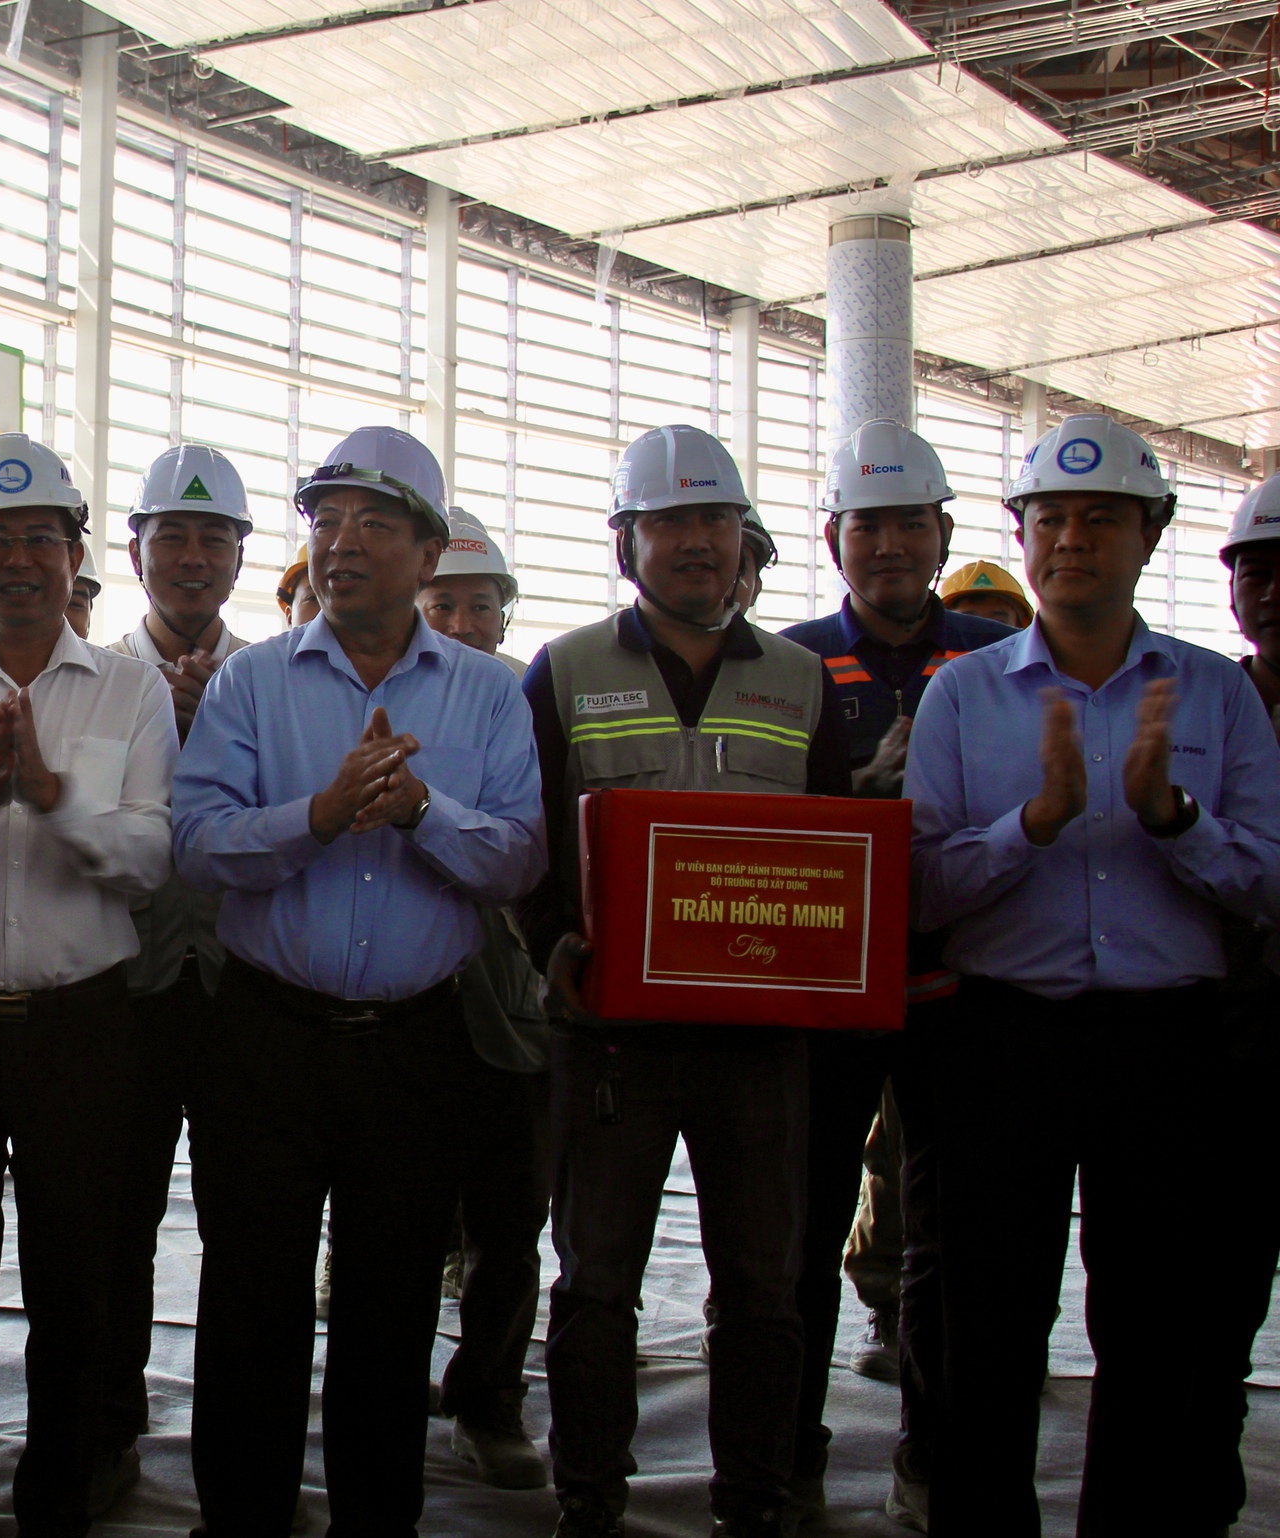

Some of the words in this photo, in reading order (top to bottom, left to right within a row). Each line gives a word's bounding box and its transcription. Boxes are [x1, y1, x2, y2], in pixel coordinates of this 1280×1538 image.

[587, 694, 620, 705] FUJITA
[623, 692, 643, 702] E&C
[687, 860, 705, 872] VIÊN
[706, 863, 723, 873] BAN
[747, 863, 770, 875] HÀNH
[771, 866, 798, 877] TRUNG
[710, 875, 721, 889] BỘ
[757, 877, 769, 890] BỘ
[770, 877, 785, 889] XÂY
[672, 891, 724, 923] TRẦN
[729, 894, 786, 926] HỒNG
[792, 904, 844, 929] MINH
[728, 934, 778, 964] Tặng
